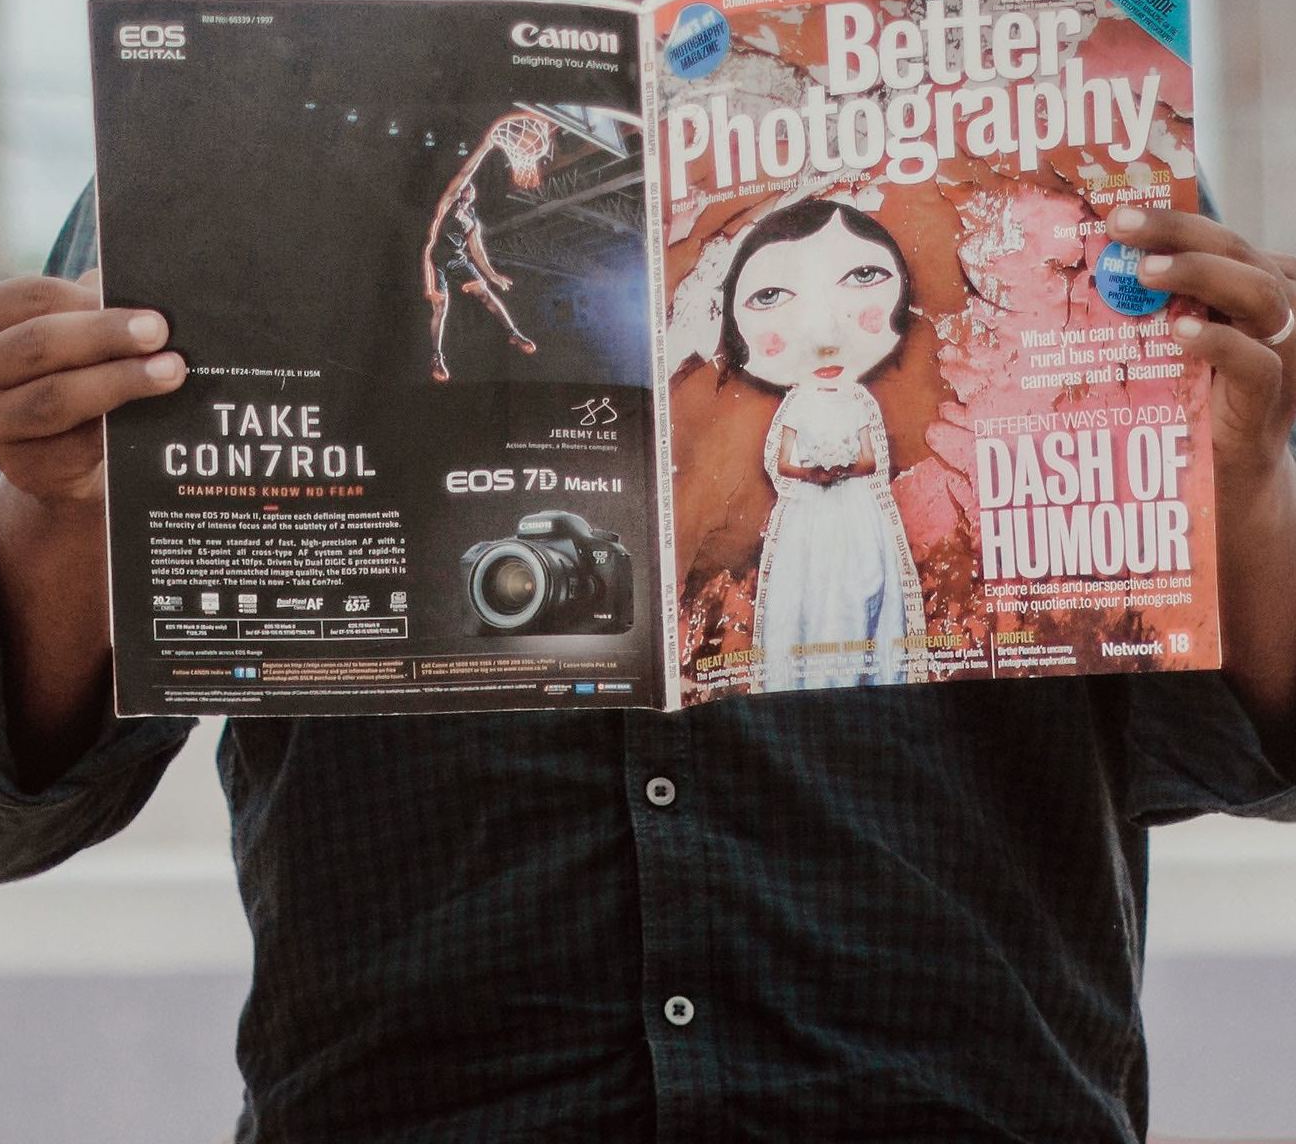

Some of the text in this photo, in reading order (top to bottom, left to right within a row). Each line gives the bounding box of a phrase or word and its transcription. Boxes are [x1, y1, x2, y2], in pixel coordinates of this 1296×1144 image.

[119, 25, 186, 48] EOS
[511, 23, 619, 54] Canon
[120, 49, 187, 60] DIGITAL
[680, 40, 720, 71] MAGAZINE
[512, 55, 619, 73] Delighting You Always
[666, 59, 1161, 198] Photography
[738, 184, 765, 196] Better
[1090, 191, 1114, 205] Sony
[1116, 188, 1142, 203] Alpha
[1144, 184, 1171, 199] A7M2
[1054, 222, 1092, 239] Sony DT
[1103, 257, 1125, 274] FOR
[1021, 320, 1169, 350] What you can do with
[1030, 350, 1065, 368] rural
[1069, 346, 1095, 365] bus
[1099, 343, 1141, 362] route,
[196, 367, 210, 375] ISO
[210, 367, 225, 375] 640
[231, 367, 273, 376] EF24-70mm
[274, 369, 297, 377] f/2.8L
[1020, 363, 1185, 391] cameras and a scanner
[658, 386, 666, 412] STANLEY
[213, 404, 322, 438] TAKE
[975, 405, 1187, 437] DIFFERENT WAYS TO ADD A
[549, 429, 618, 441] JEREMY LEE
[505, 442, 528, 450] Action
[165, 443, 377, 479] CON7ROL
[976, 429, 1115, 509] DASH
[1127, 425, 1189, 501] OF
[446, 469, 623, 493] EOS 7D Mark II
[178, 484, 365, 497] CHAMPIONS KNOW NO FEAR
[149, 511, 169, 520] With
[170, 511, 184, 520] the
[202, 511, 219, 520] EOS
[231, 511, 251, 520] Mark
[262, 513, 293, 523] capture
[294, 512, 312, 521] each
[313, 512, 346, 522] defining
[347, 511, 381, 520] moment
[382, 510, 401, 519] with
[149, 521, 402, 532] the ferocity intense focus and the subtlety masterstroke.
[150, 537, 184, 546] Embrace
[188, 537, 202, 546] the
[226, 538, 261, 547] standard
[301, 538, 358, 548] high-precision
[377, 537, 396, 545] with
[980, 500, 1191, 580] HUMOUR
[150, 548, 193, 557] responsive
[197, 548, 231, 557] 65-point
[251, 549, 293, 558] cross-type
[314, 549, 343, 558] system
[348, 548, 363, 556] and
[368, 547, 406, 556] rapid-fire
[151, 558, 323, 567] continuous shooting Driven Dual
[186, 569, 208, 577] range
[270, 568, 294, 577] image
[370, 567, 390, 575] Mark
[152, 578, 344, 587] the game changer. The time Take Con7rol.
[985, 575, 1192, 601] Explore ideas and perspectives to lend
[152, 596, 171, 606] 20.2
[306, 597, 324, 611] AF
[985, 592, 1192, 616] a funny quotient to your photographs
[996, 631, 1035, 645] PROFILE
[1101, 633, 1190, 657] Network 18
[696, 654, 723, 672] GREAT
